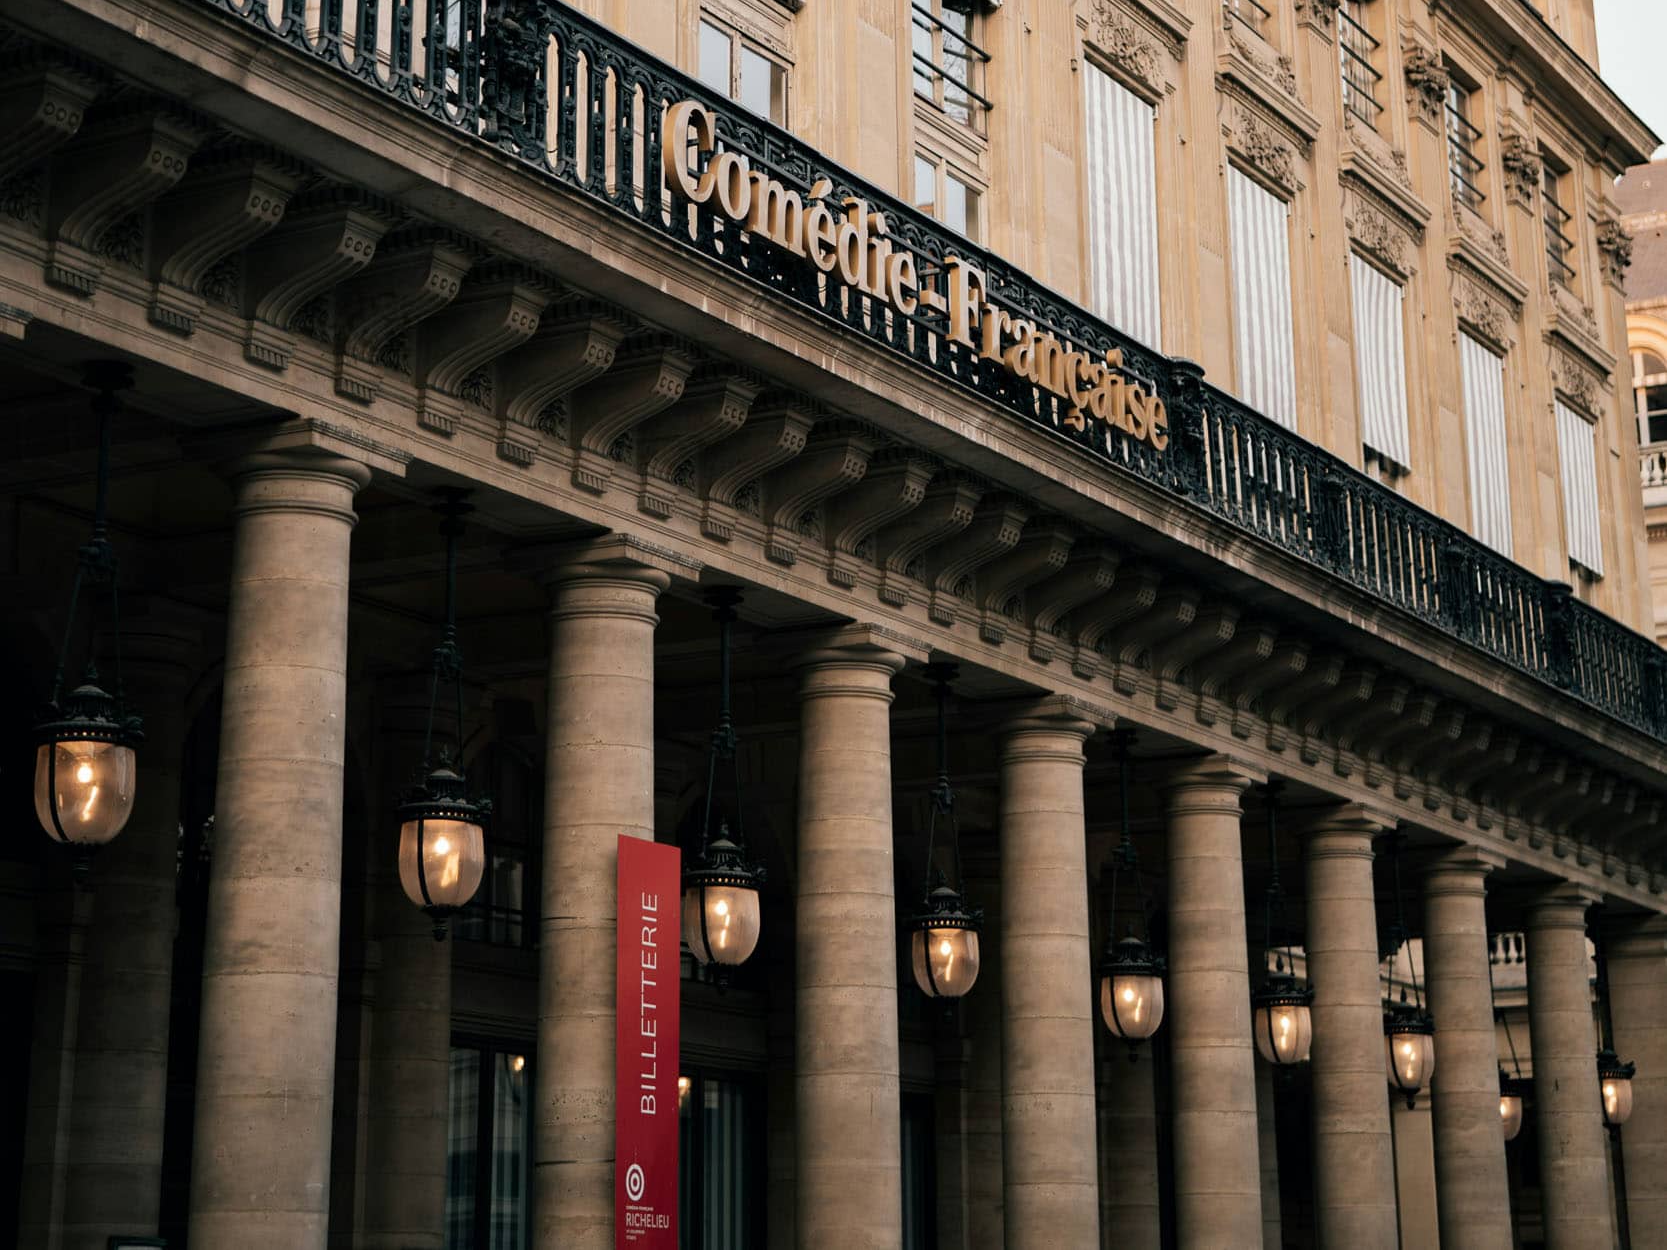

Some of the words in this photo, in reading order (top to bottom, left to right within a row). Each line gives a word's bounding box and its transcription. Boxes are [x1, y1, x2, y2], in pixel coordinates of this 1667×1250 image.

[662, 100, 1168, 450] Comédie-Française
[641, 892, 658, 1115] BILLETTERIE
[626, 1212, 669, 1228] RICHELIEU
